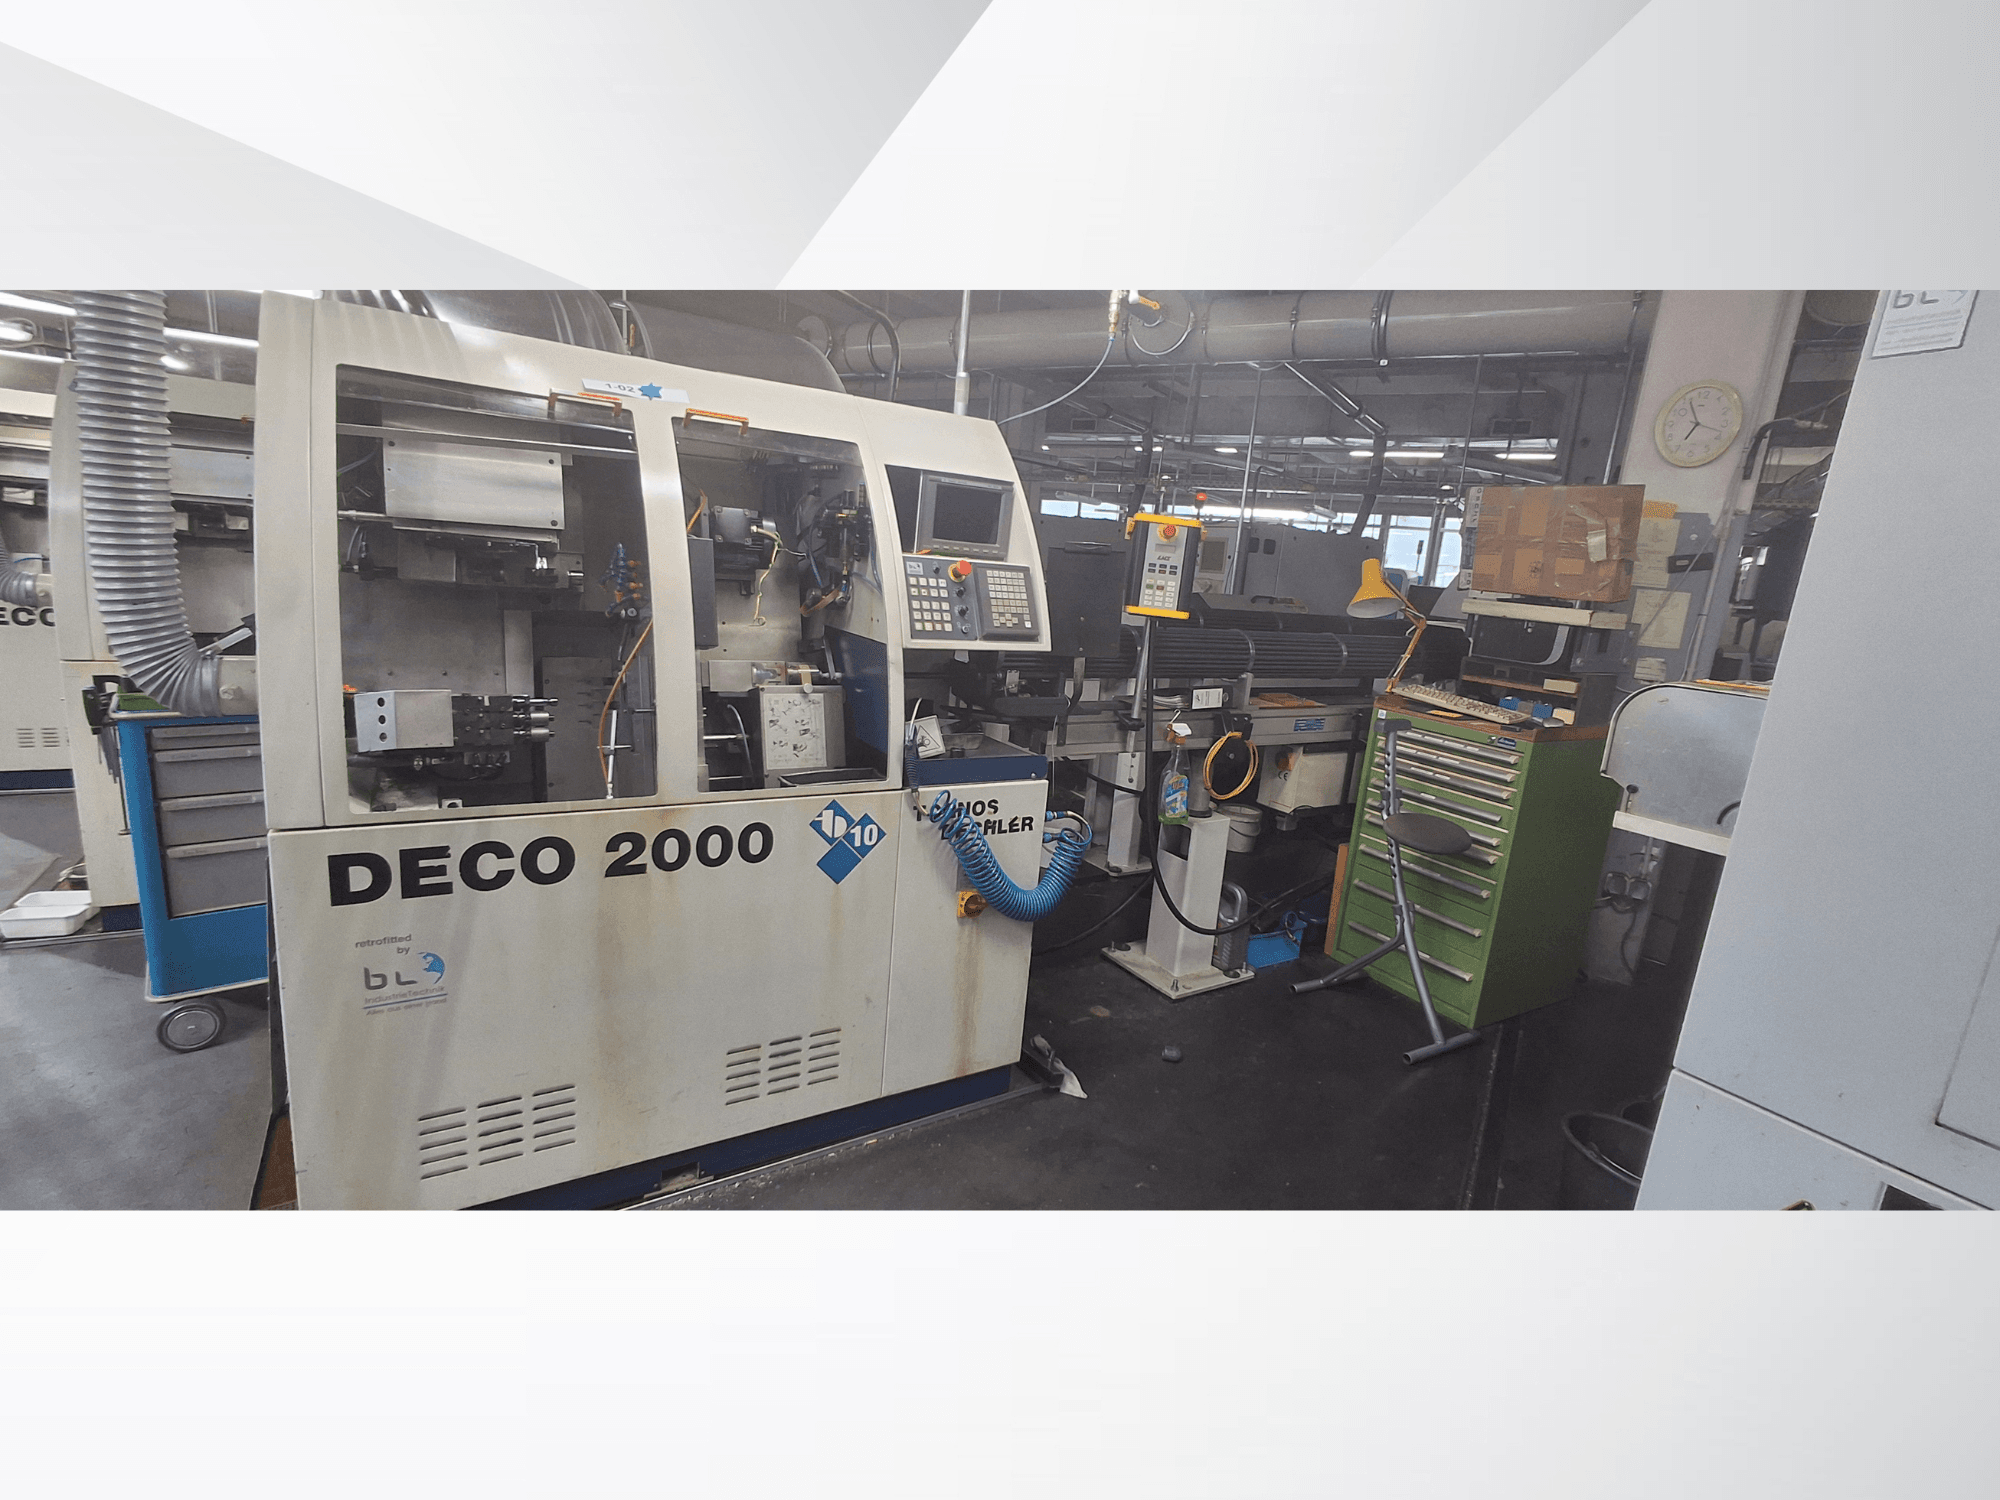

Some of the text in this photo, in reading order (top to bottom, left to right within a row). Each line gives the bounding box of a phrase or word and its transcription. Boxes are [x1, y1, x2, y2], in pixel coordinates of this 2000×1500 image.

[605, 383, 636, 393] 1-02
[912, 799, 999, 822] TNOS
[850, 823, 879, 848] 10
[940, 815, 1034, 841] HLER
[328, 822, 774, 906] DECO 2000
[355, 933, 412, 949] retrofitted
[397, 946, 411, 955] by
